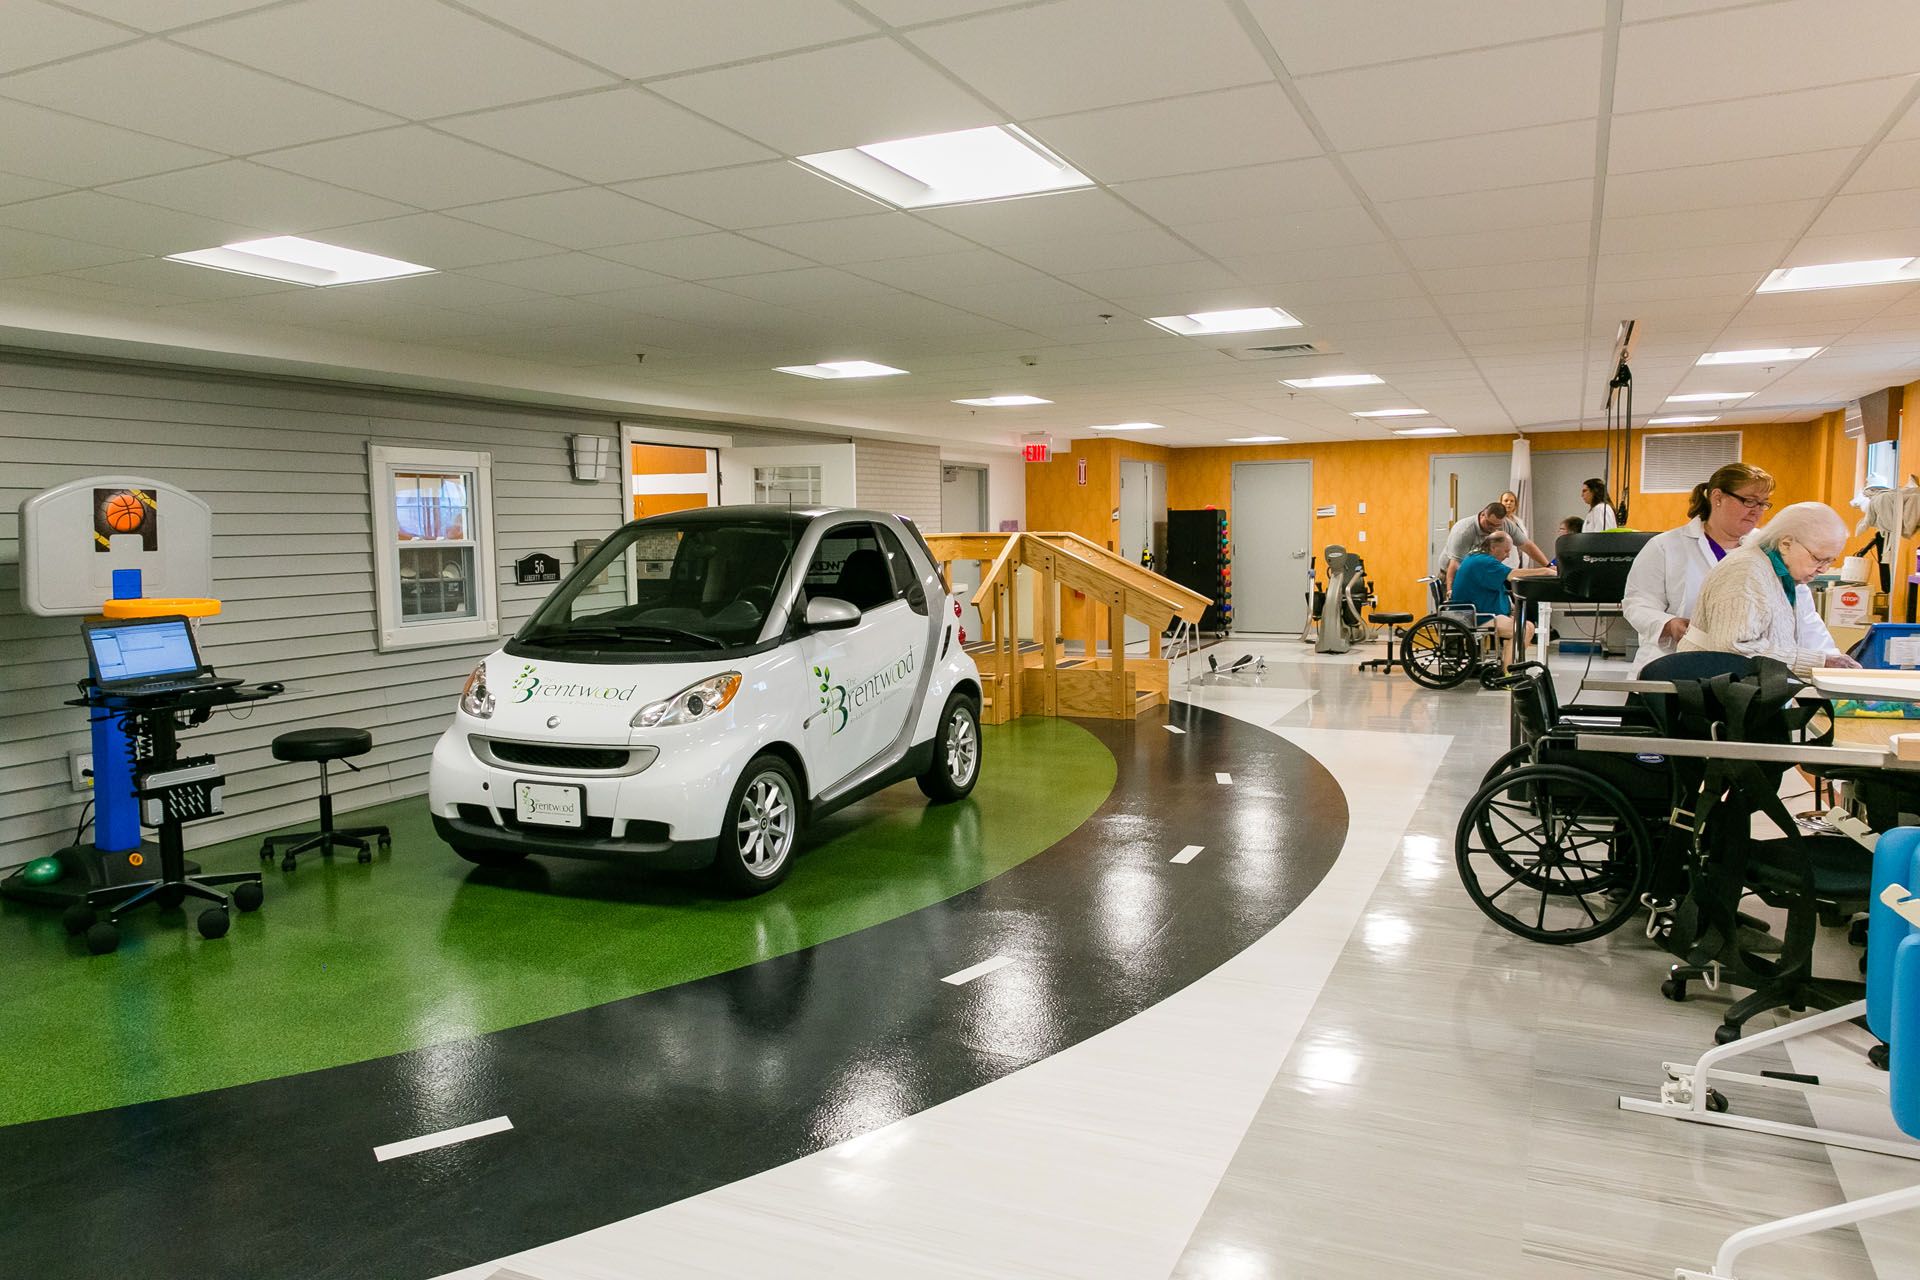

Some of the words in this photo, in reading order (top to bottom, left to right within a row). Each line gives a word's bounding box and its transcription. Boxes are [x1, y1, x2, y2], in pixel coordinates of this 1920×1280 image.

[1026, 445, 1047, 461] EXIT
[1583, 555, 1635, 563] SportsAr
[534, 560, 545, 574] 56
[524, 574, 541, 582] LIBERTY
[511, 677, 637, 704] Brentwood
[831, 645, 914, 736] Brentwood
[528, 798, 574, 813] Brentwood
